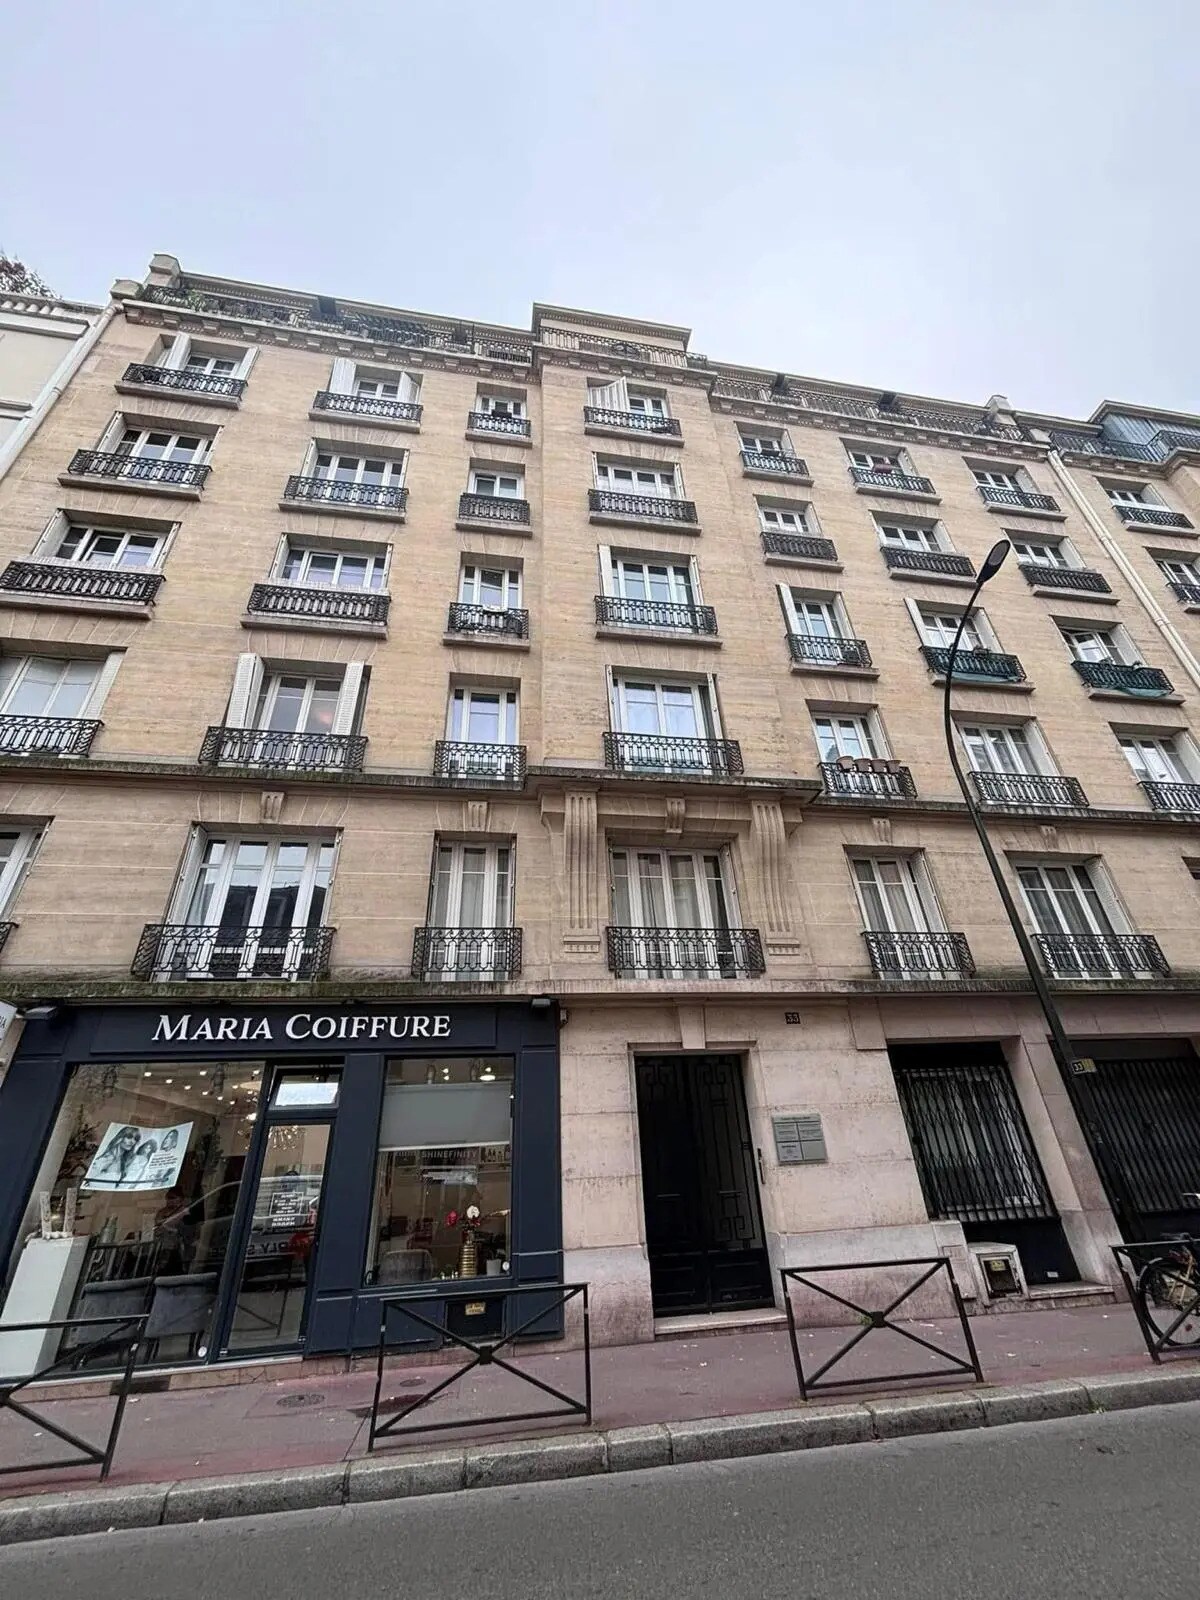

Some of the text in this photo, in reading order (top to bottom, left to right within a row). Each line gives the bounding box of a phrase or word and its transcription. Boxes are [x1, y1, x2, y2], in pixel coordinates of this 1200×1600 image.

[151, 1013, 451, 1041] MARIA COIFFURE
[421, 1149, 478, 1159] SHINEFINITY
